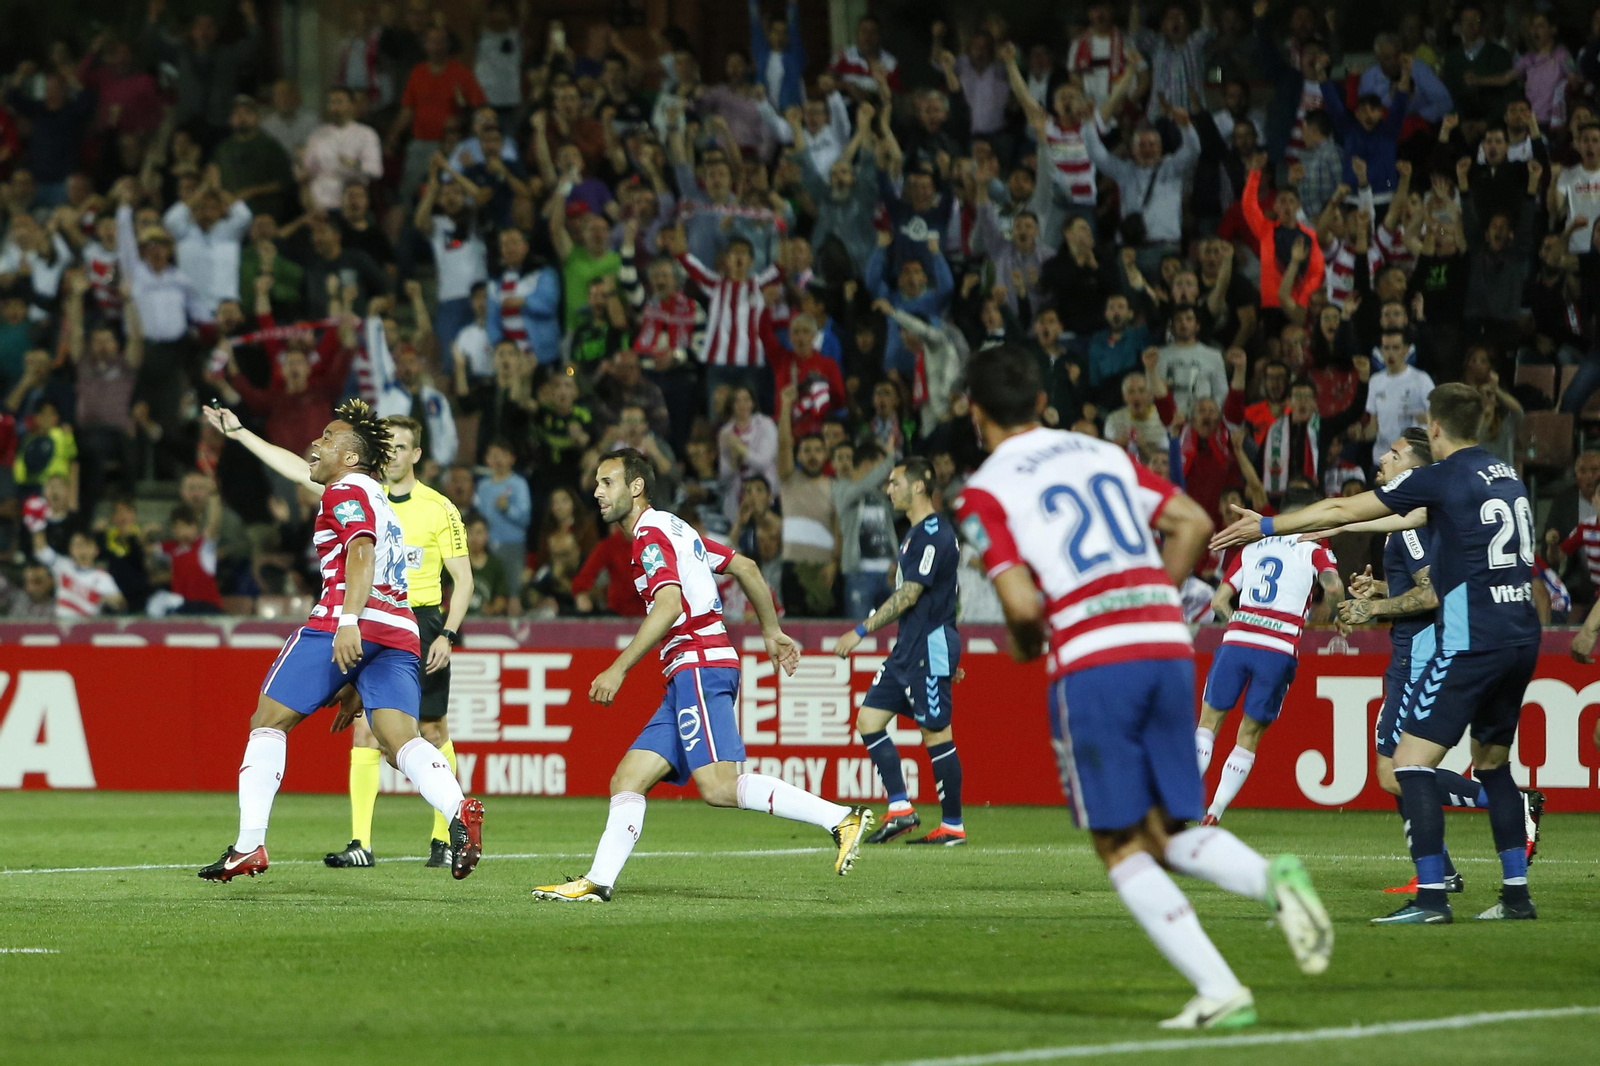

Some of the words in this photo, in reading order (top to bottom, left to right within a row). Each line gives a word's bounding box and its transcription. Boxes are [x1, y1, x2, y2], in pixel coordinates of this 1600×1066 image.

[1039, 472, 1147, 577] 20
[1480, 496, 1536, 570] 20
[1248, 555, 1284, 607] 3
[485, 753, 567, 795] KING
